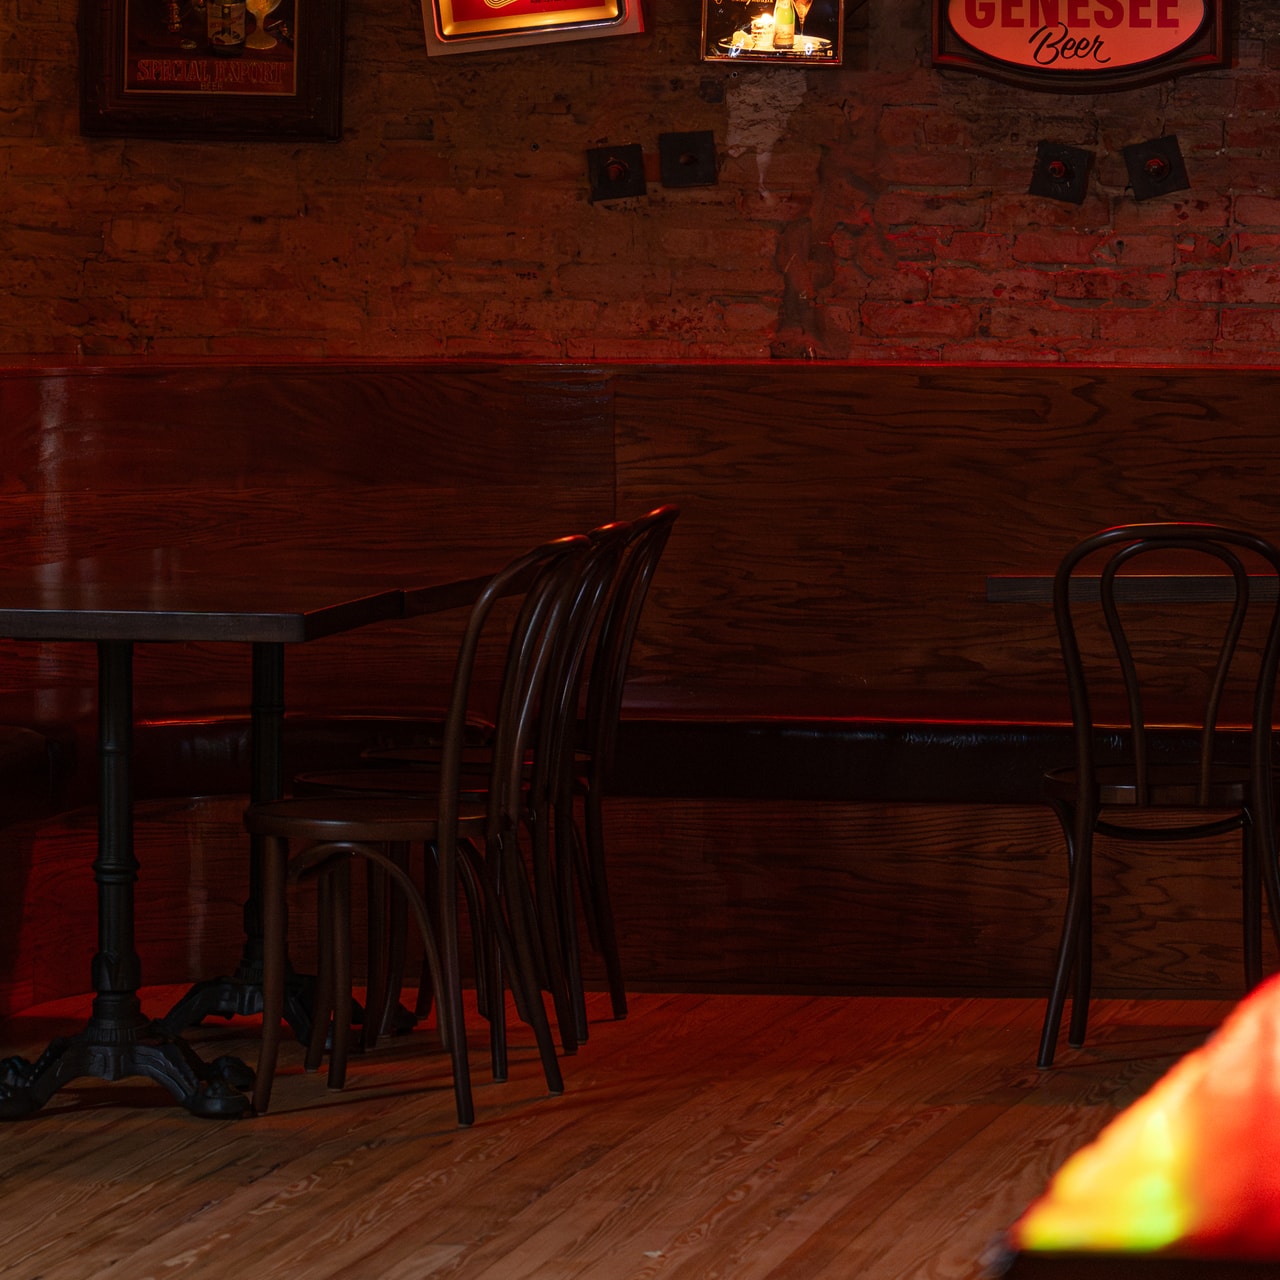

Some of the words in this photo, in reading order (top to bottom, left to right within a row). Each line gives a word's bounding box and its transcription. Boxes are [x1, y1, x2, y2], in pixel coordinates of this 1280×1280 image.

[1028, 21, 1111, 65] Beer
[137, 59, 211, 82] SPECIAL
[212, 61, 286, 84] EXPORT
[200, 82, 224, 91] BEER
